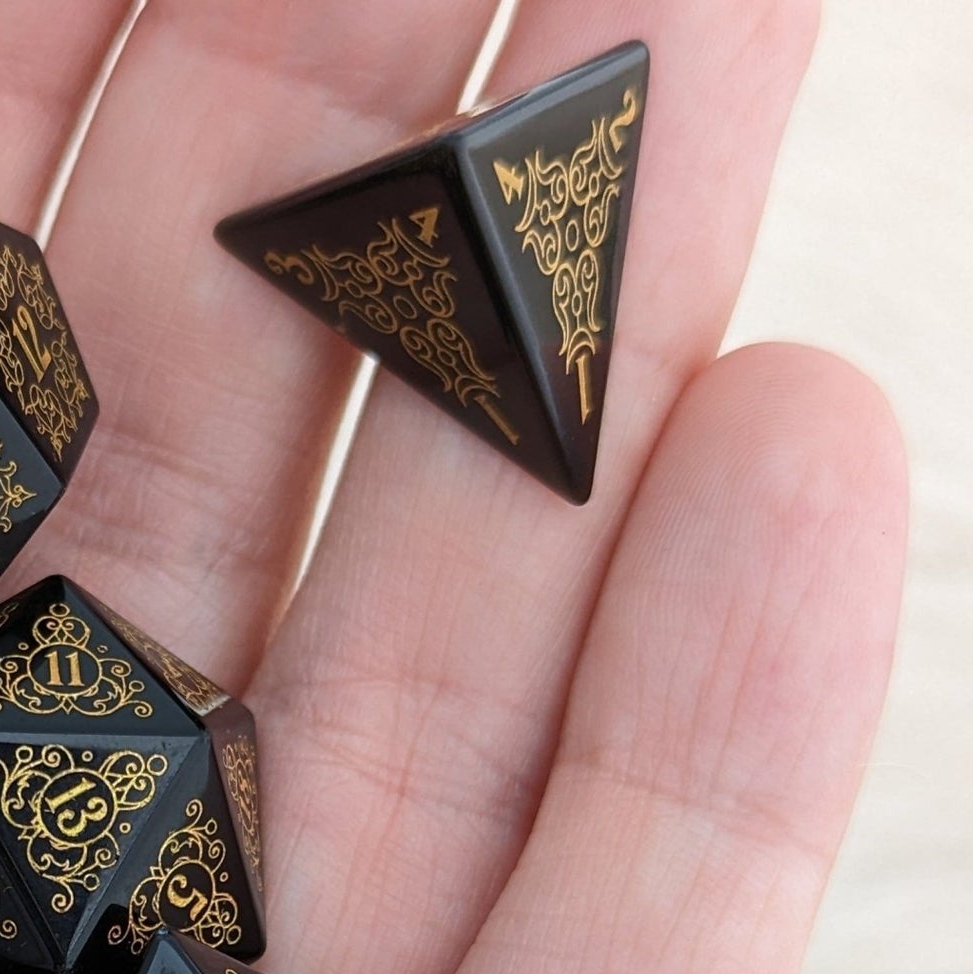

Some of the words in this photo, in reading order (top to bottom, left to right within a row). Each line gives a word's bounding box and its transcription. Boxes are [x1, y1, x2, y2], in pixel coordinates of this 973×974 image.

[494, 161, 525, 204] 4
[409, 207, 440, 248] 4
[264, 251, 314, 285] 3
[11, 305, 52, 383] 12
[576, 356, 592, 425] 1
[478, 395, 521, 446] 1
[44, 649, 85, 687] 11
[45, 777, 107, 837] 13
[166, 875, 208, 921] 5
